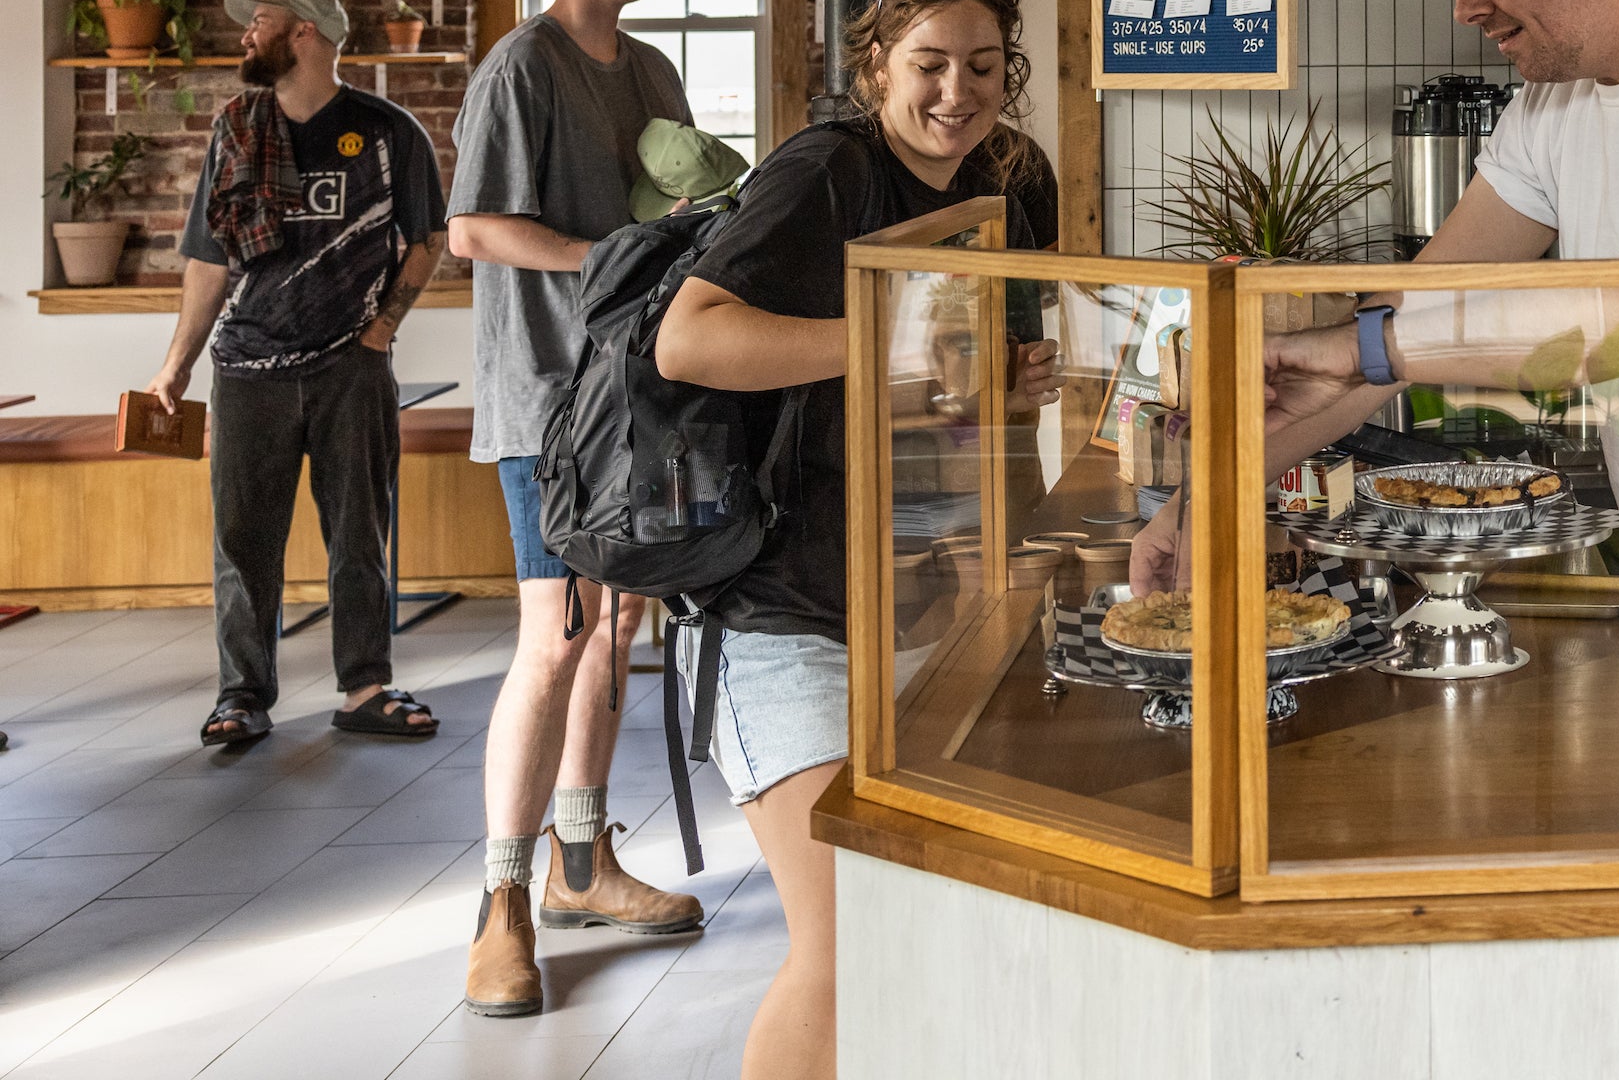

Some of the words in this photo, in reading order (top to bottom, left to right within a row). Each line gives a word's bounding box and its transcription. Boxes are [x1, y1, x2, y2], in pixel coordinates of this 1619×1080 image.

[1169, 18, 1206, 34] 350/4
[1180, 41, 1206, 54] CUPS
[1242, 38, 1264, 53] 25¢
